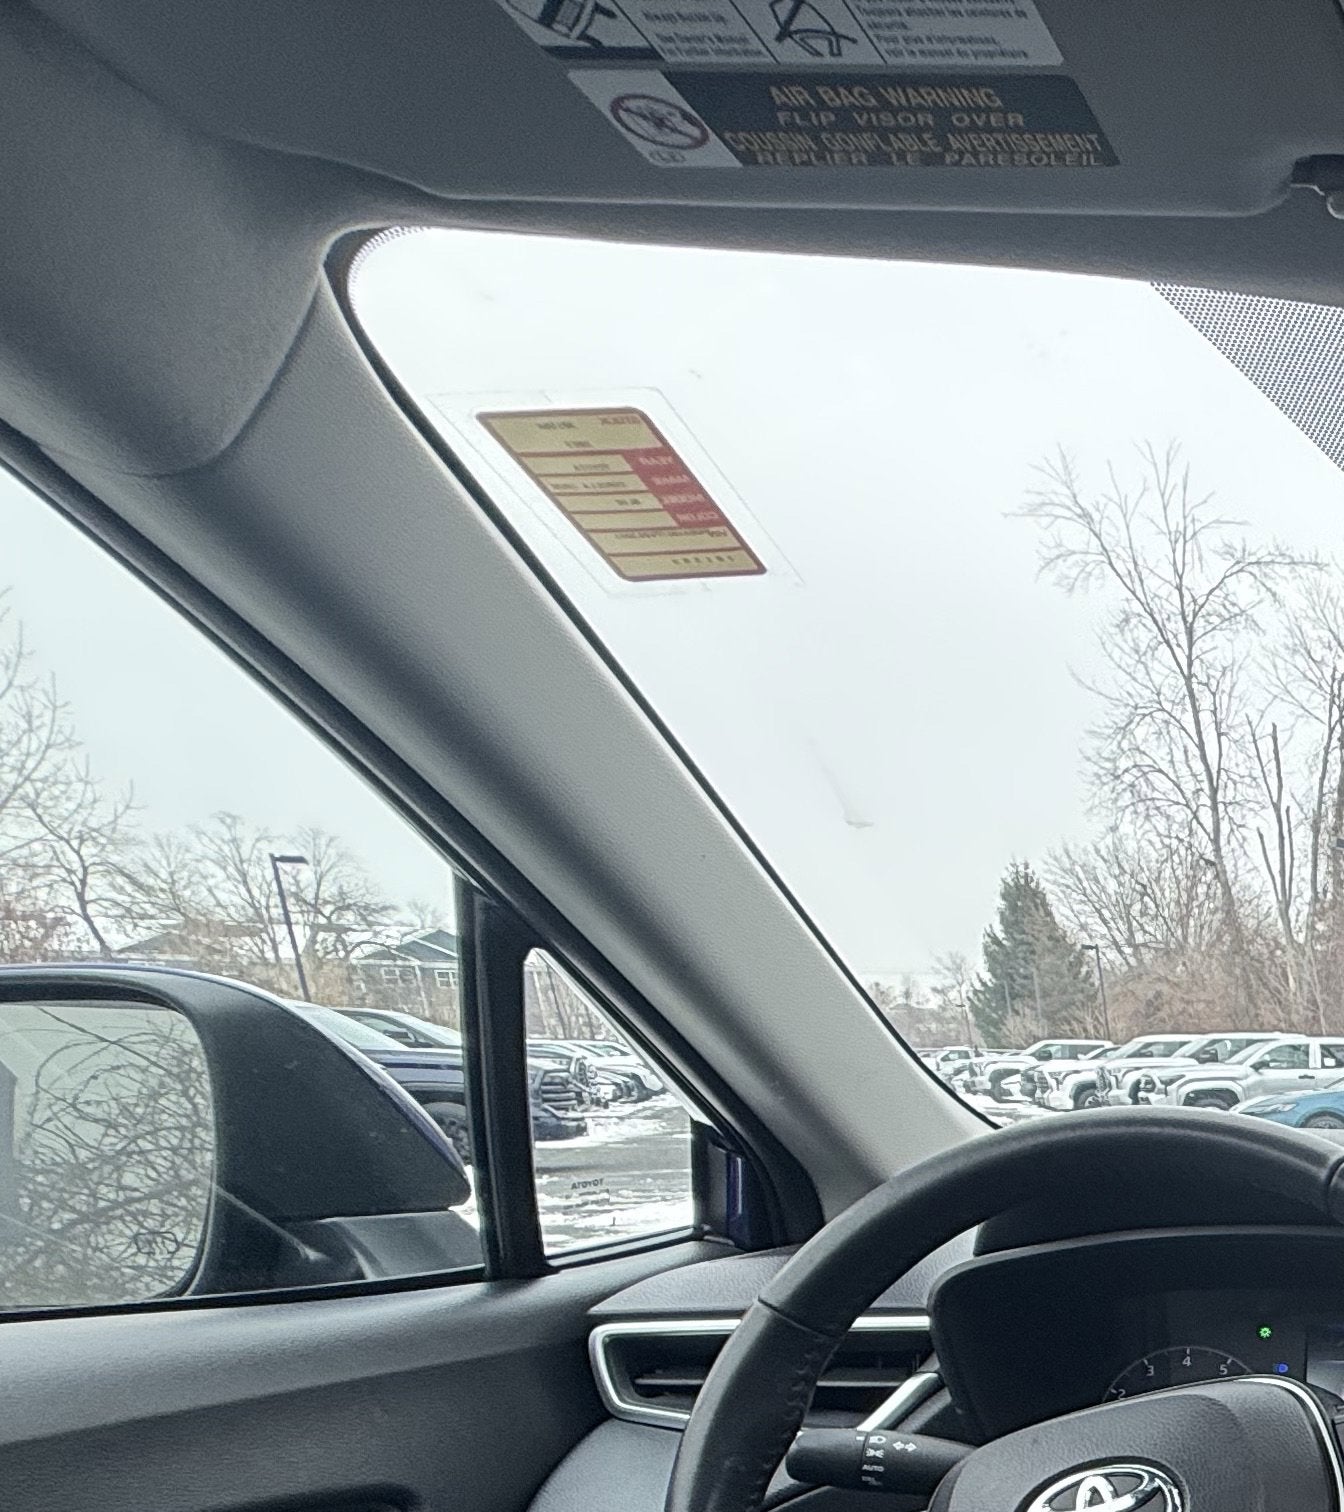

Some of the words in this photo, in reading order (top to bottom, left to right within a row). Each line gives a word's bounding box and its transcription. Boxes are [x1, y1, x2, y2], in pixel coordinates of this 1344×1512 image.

[769, 86, 816, 107] AIR
[816, 86, 879, 107] BAG
[879, 87, 1003, 108] WARNING
[776, 111, 836, 126] FLIP
[853, 112, 934, 127] VISOR
[951, 113, 1024, 127] OVER
[723, 132, 818, 150] COUSSIN
[947, 133, 1101, 151] AVERTISSEMENT
[1182, 1356, 1191, 1367] 4
[1146, 1366, 1154, 1376] 3
[1219, 1364, 1227, 1375] 5
[862, 1464, 884, 1472] AUTO
